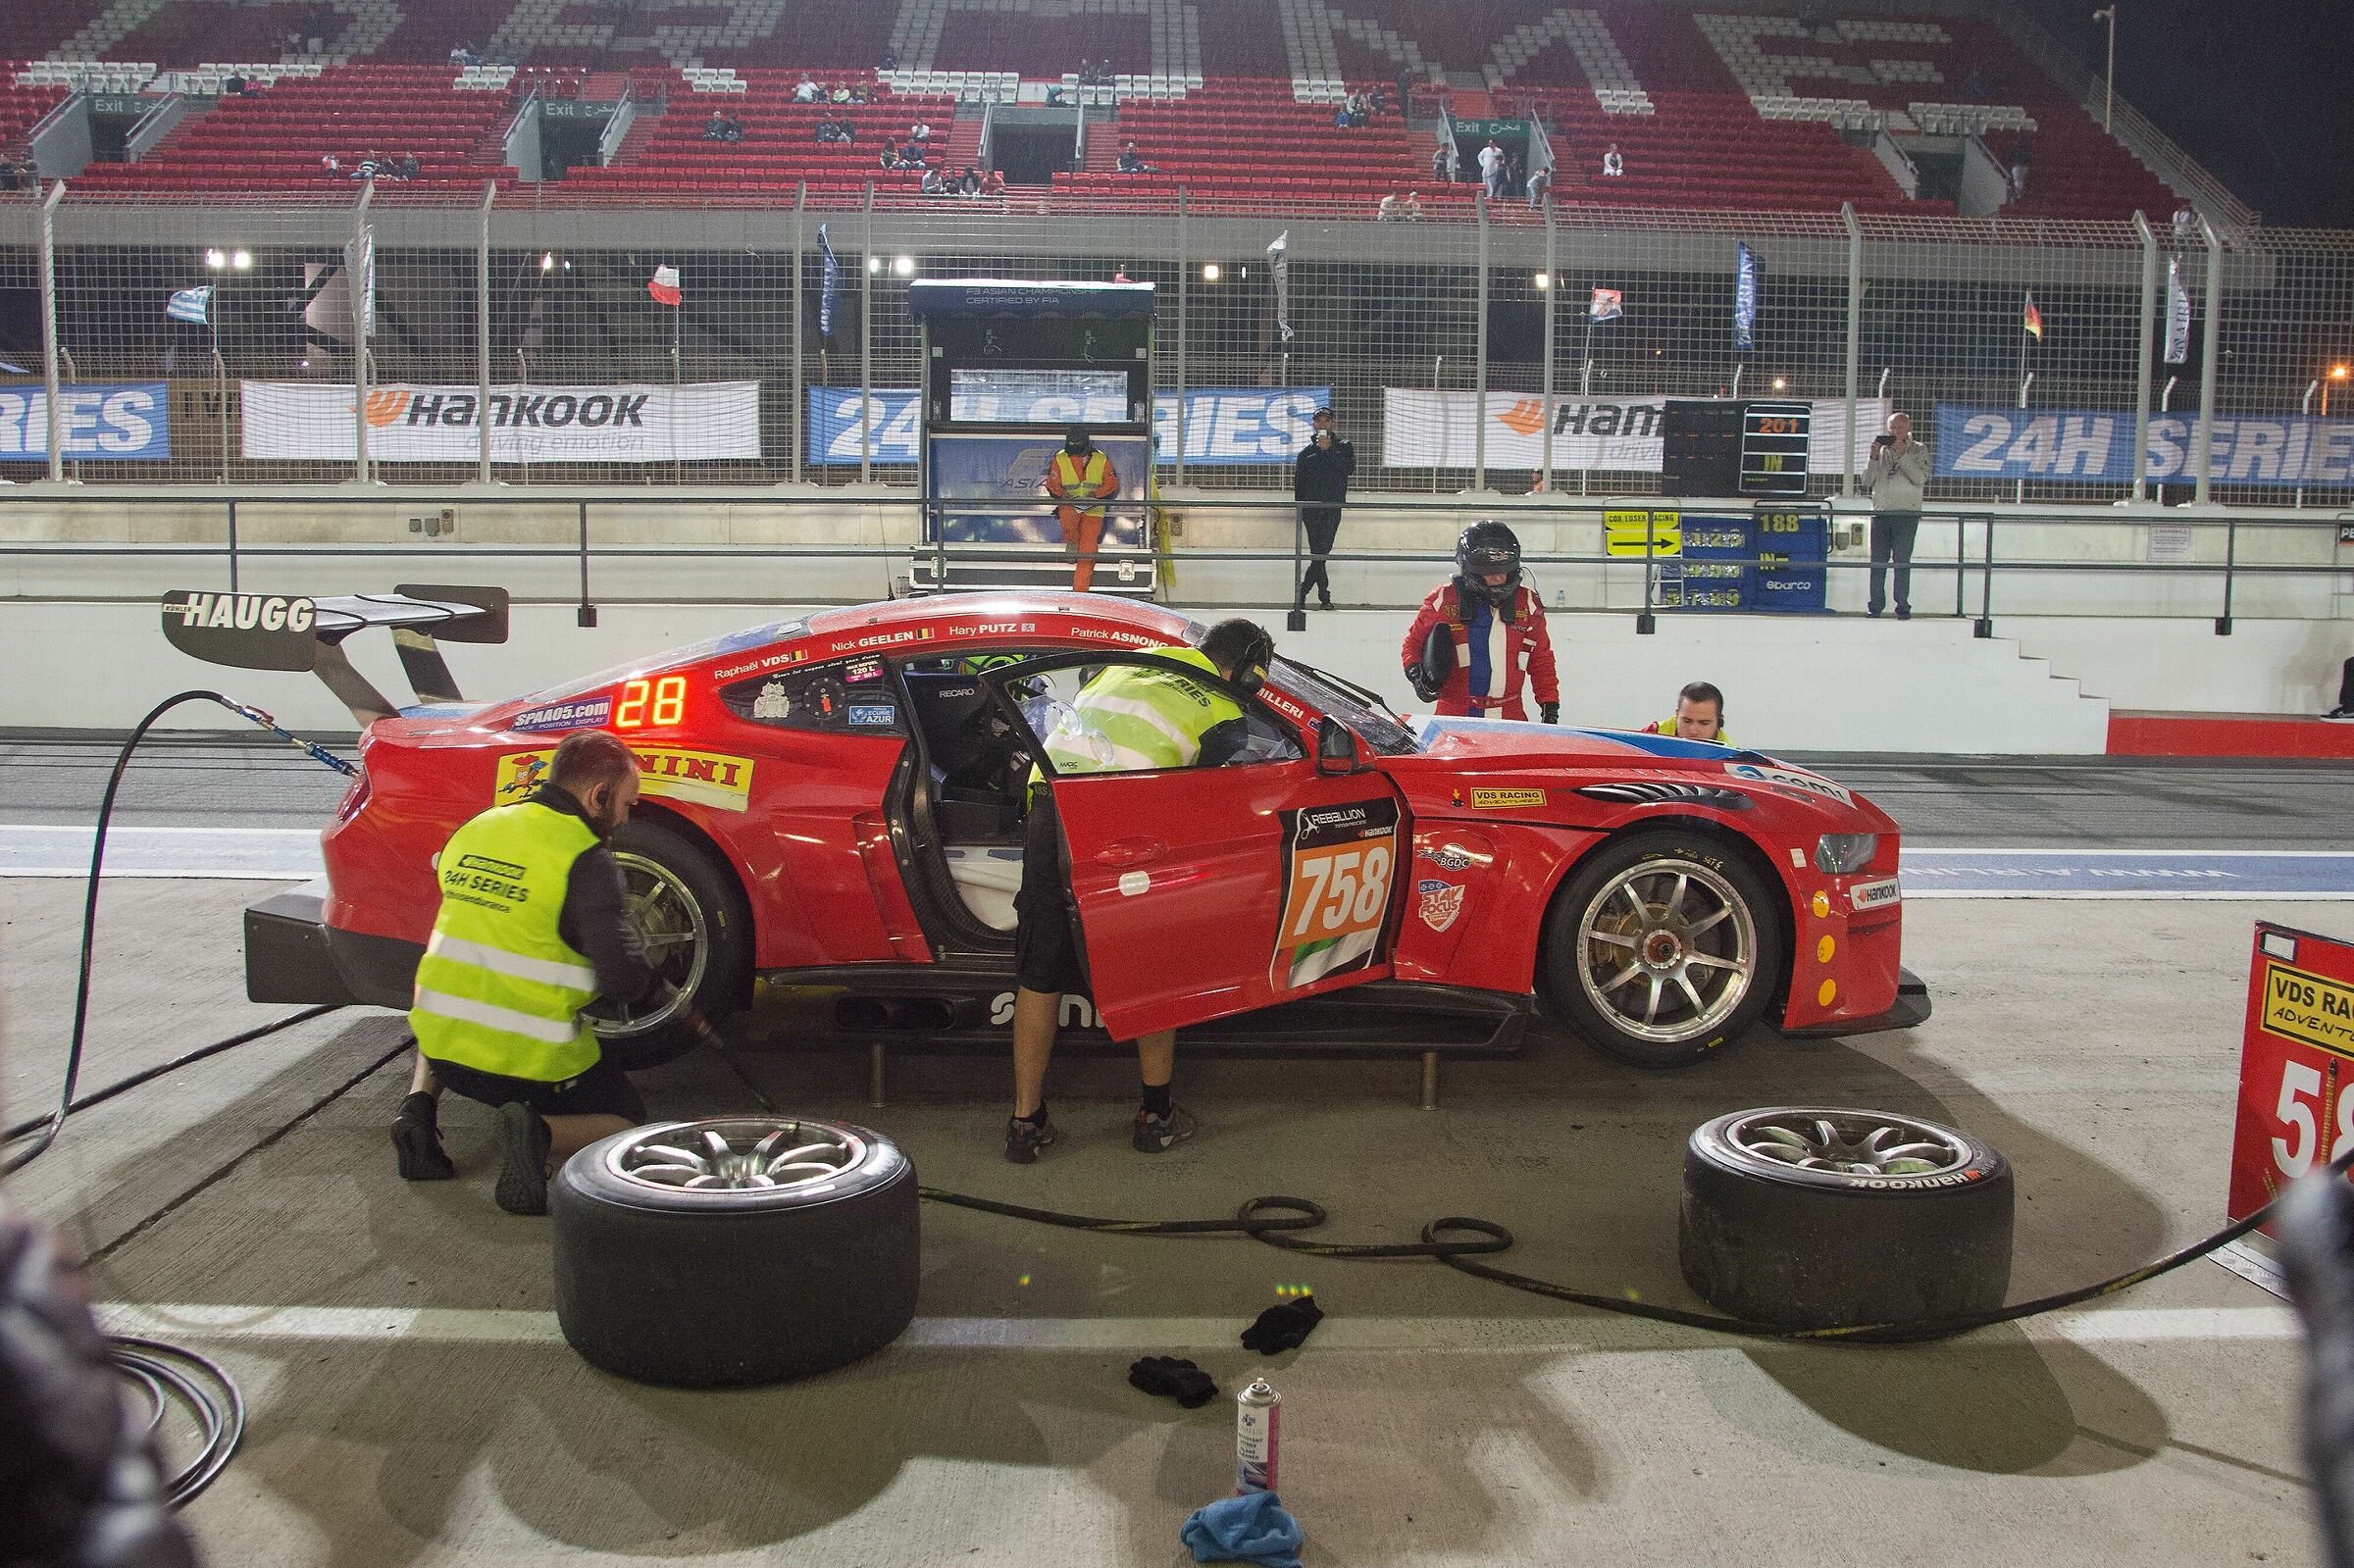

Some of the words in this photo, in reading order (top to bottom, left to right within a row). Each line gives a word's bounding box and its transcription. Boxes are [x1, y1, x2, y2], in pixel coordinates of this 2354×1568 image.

[95, 99, 124, 112] Exit
[545, 103, 574, 116] Exit
[1456, 122, 1480, 133] Exit
[1490, 122, 1521, 134] مخرج
[1760, 418, 1799, 433] 201
[465, 430, 542, 455] diving
[549, 431, 644, 451] emotion
[1953, 415, 2115, 475] 24H
[2145, 419, 2354, 480] SERIE
[1761, 514, 1799, 532] 188
[183, 593, 314, 632] HAUGG
[949, 626, 977, 636] Hary
[979, 623, 1017, 633] PUTZ
[1071, 627, 1109, 639] Patrick
[832, 639, 856, 652] Nick
[859, 632, 914, 647] GEELEN
[714, 661, 759, 680] Raphaël
[760, 653, 791, 669] VDS
[616, 676, 687, 729] 28
[940, 688, 975, 698] RECARO
[515, 702, 609, 726] SPAA05.com
[1440, 858, 1469, 868] BGDC
[471, 876, 529, 903] SERIES
[1294, 847, 1389, 936] 758
[2275, 977, 2315, 1008] VDS
[2322, 990, 2354, 1020] RA
